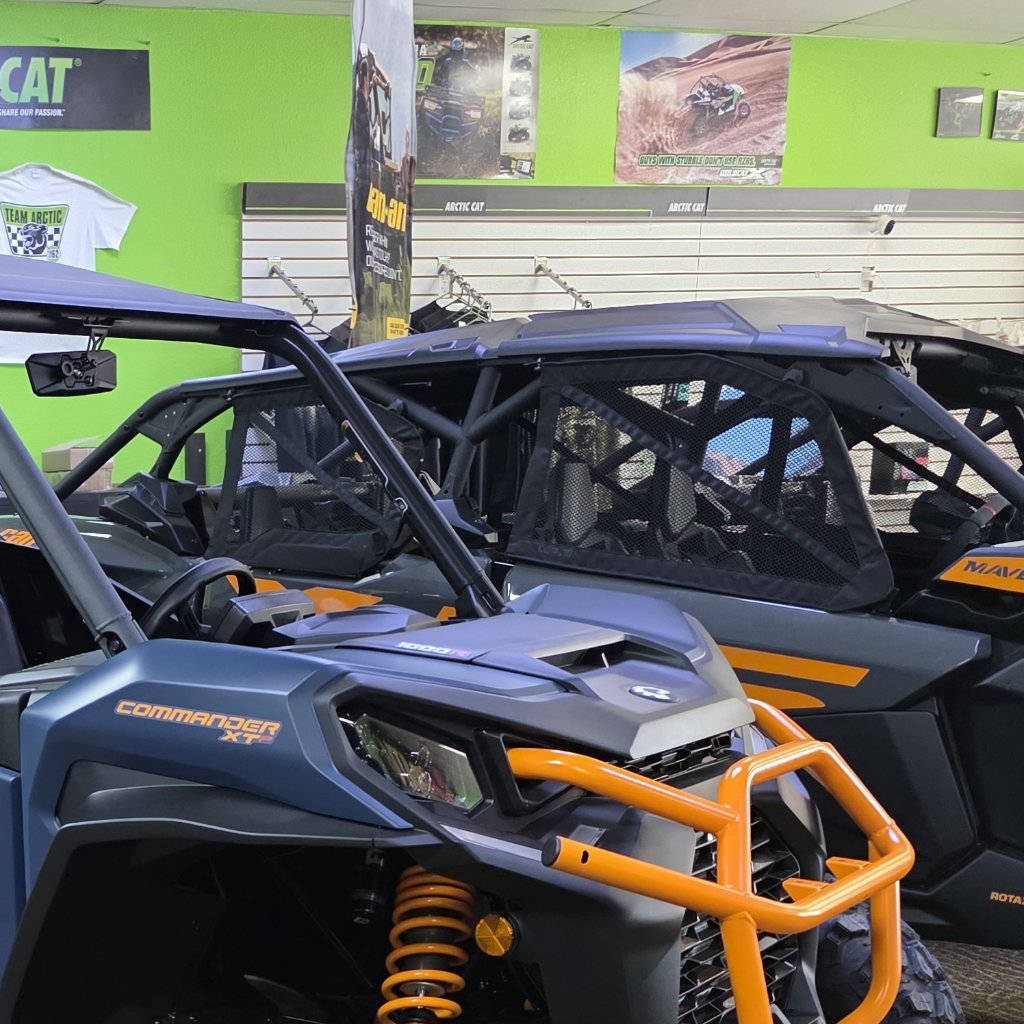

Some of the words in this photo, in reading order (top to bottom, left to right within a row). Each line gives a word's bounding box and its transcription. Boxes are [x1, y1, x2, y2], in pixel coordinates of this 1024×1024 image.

[20, 108, 34, 117] OUR
[639, 155, 657, 166] GUYS
[658, 155, 675, 166] WITH
[676, 155, 703, 166] STUBBLE
[704, 155, 723, 166] DON'T
[724, 155, 737, 166] USE
[444, 201, 470, 212] ARCTIC
[470, 201, 485, 212] CAT
[668, 202, 692, 213] ARCTIC
[692, 202, 705, 212] CAT
[872, 203, 895, 213] ARCTIC
[894, 204, 907, 213] CAT
[5, 208, 28, 224] TEAM
[31, 209, 62, 224] ARCTIC
[115, 700, 282, 735] COMMANDER
